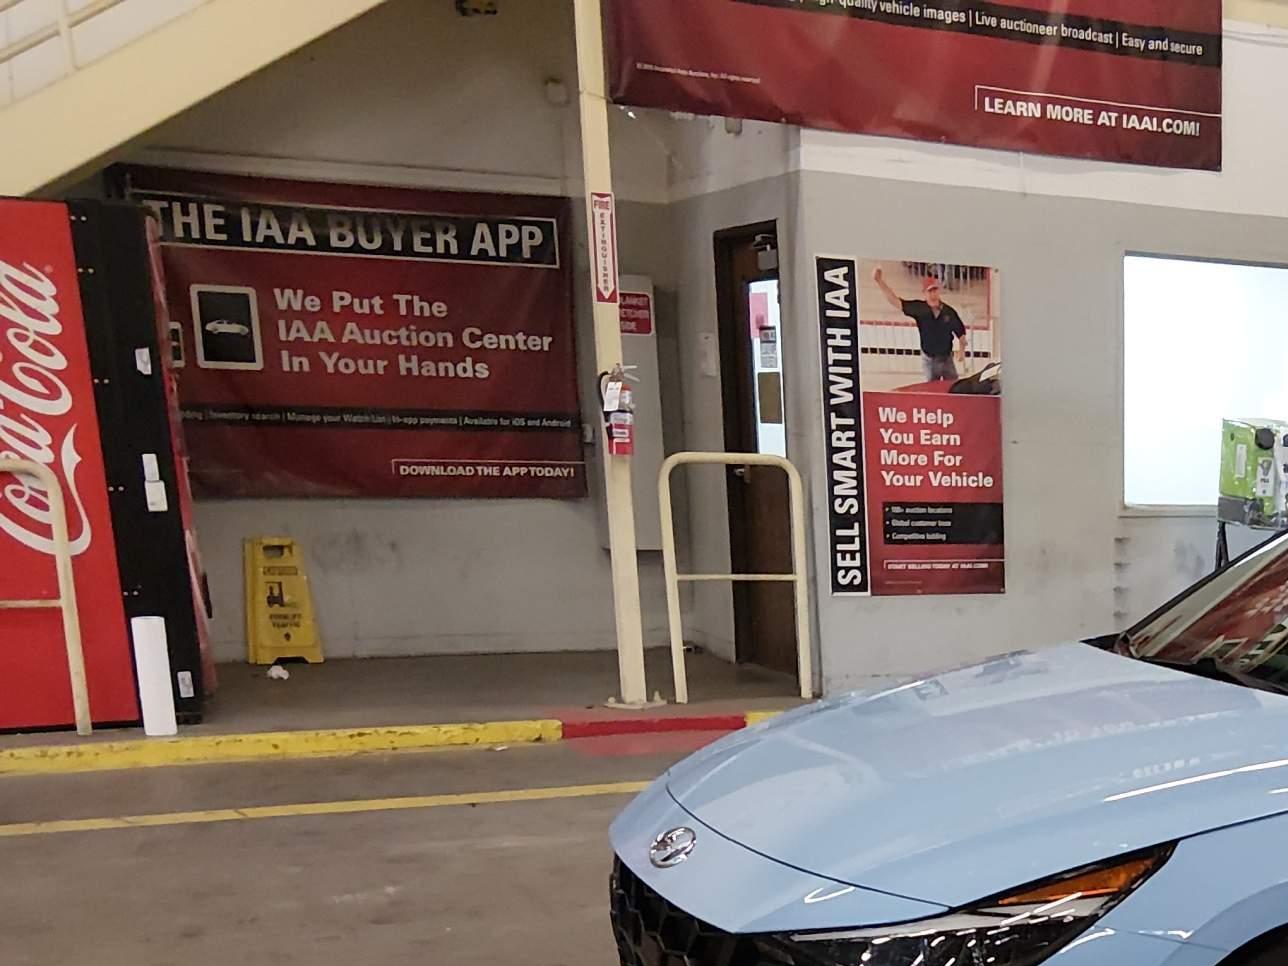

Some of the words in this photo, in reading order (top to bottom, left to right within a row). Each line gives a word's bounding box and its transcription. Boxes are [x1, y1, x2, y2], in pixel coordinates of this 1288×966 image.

[880, 0, 920, 17] vehicle
[923, 4, 966, 23] images
[975, 12, 997, 27] Live
[1000, 17, 1058, 36] auctioneer
[1061, 23, 1113, 43] broadcast
[1122, 33, 1145, 51] Easy
[1148, 37, 1168, 51] and
[1170, 42, 1202, 55] secure
[984, 97, 1041, 117] LEARN
[1047, 106, 1093, 125] MORE
[1098, 113, 1118, 128] AT
[1123, 115, 1200, 137] IAAI.COM!
[143, 200, 227, 240] THE
[241, 206, 315, 246] IAA
[330, 213, 458, 255] BUYER
[471, 223, 543, 258] APP
[273, 288, 321, 313] We
[333, 292, 383, 316] Put
[394, 294, 448, 318] The
[824, 266, 850, 318] IAA
[278, 320, 335, 343] IAA
[342, 323, 454, 348] Auction
[462, 327, 552, 352] Center
[280, 350, 309, 372] In
[319, 352, 388, 375] Your
[399, 355, 489, 379] Hands
[826, 328, 854, 405] WITH
[879, 407, 906, 423] We
[913, 408, 953, 428] Help
[880, 428, 913, 444] You
[920, 430, 960, 445] Earn
[400, 465, 475, 476] DOWNLOAD
[476, 466, 500, 476] THE
[502, 466, 528, 476] APP
[530, 466, 574, 477] TODAY!
[831, 412, 859, 514] SMART
[881, 450, 927, 466] More
[934, 451, 962, 466] For
[881, 471, 923, 486] Your
[928, 471, 993, 487] Vehicle
[836, 522, 862, 586] SELL
